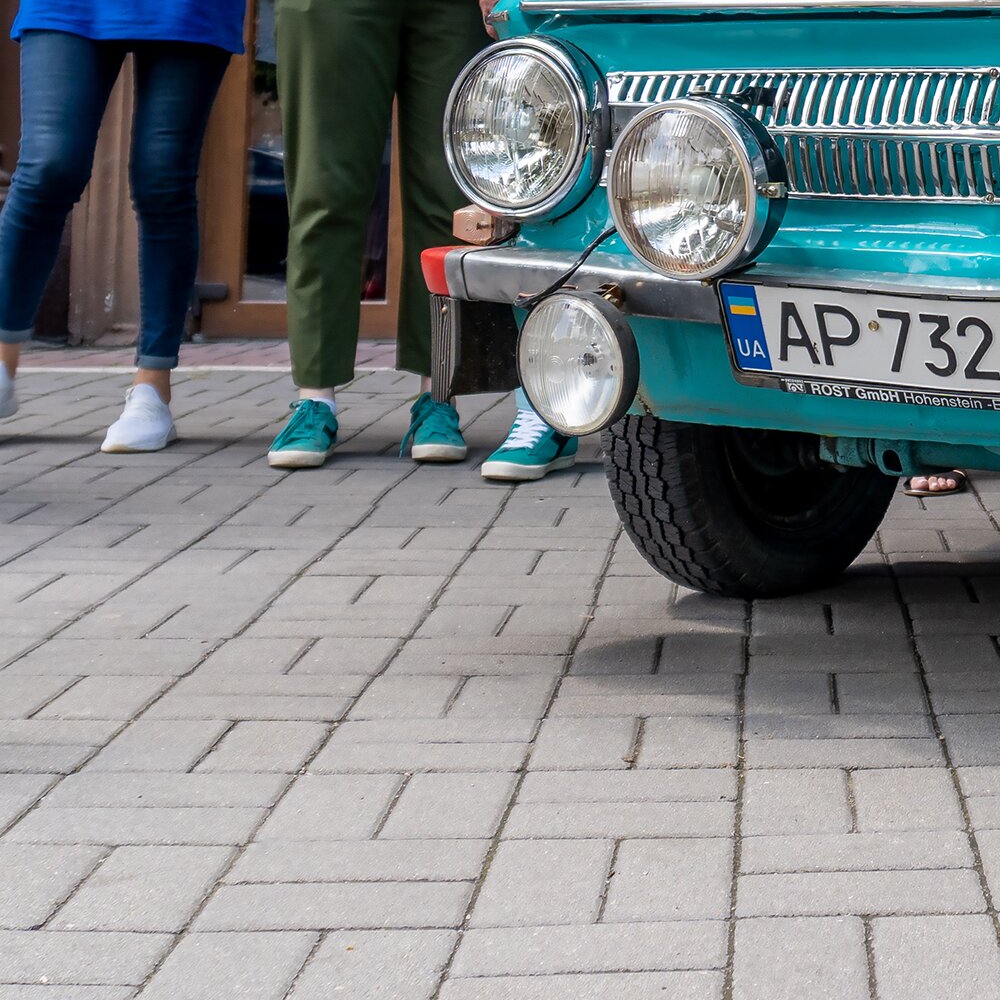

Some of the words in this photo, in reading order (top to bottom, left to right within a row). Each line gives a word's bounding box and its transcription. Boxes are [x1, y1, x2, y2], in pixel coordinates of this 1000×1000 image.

[778, 301, 861, 367] AP
[736, 337, 767, 359] UA
[810, 383, 851, 398] ROST
[855, 386, 900, 403] GmbH
[904, 391, 983, 409] Hohenstein
